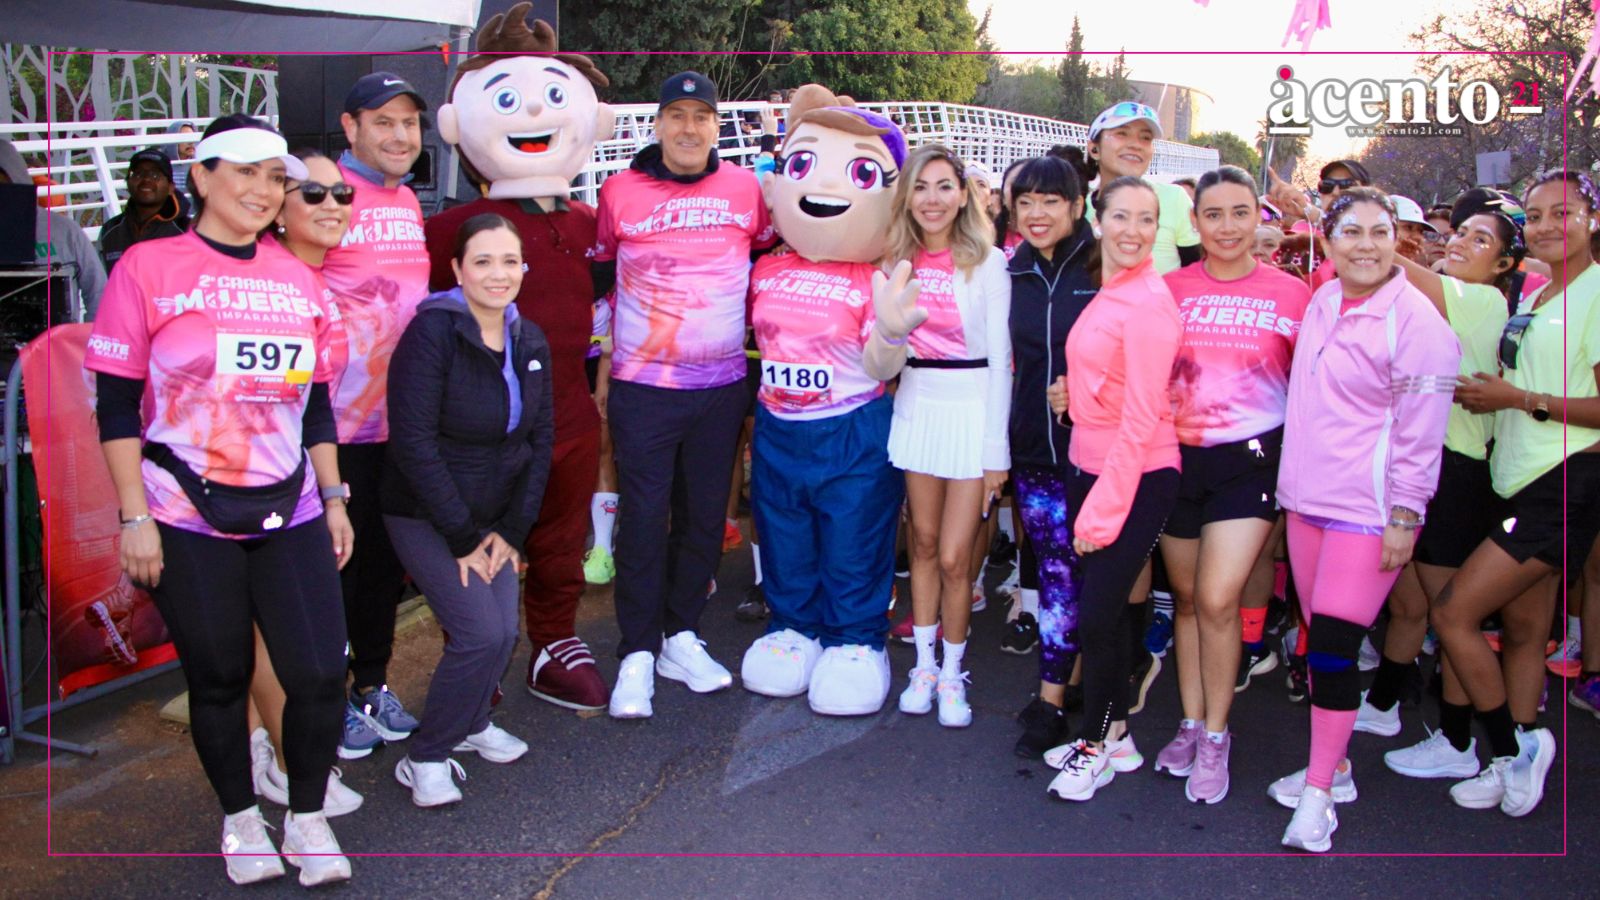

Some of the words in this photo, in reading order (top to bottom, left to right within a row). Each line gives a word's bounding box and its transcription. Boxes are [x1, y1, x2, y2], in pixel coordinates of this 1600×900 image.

[666, 197, 730, 211] CARRERA
[341, 220, 427, 248] MUJERE
[757, 277, 865, 308] MUJERES
[1196, 294, 1277, 311] CARRERA
[217, 311, 302, 325] IMPARABLES
[1179, 306, 1295, 337] UJERES
[1185, 325, 1259, 337] MPARABLES
[236, 341, 303, 371] 597
[766, 365, 829, 389] 1180
